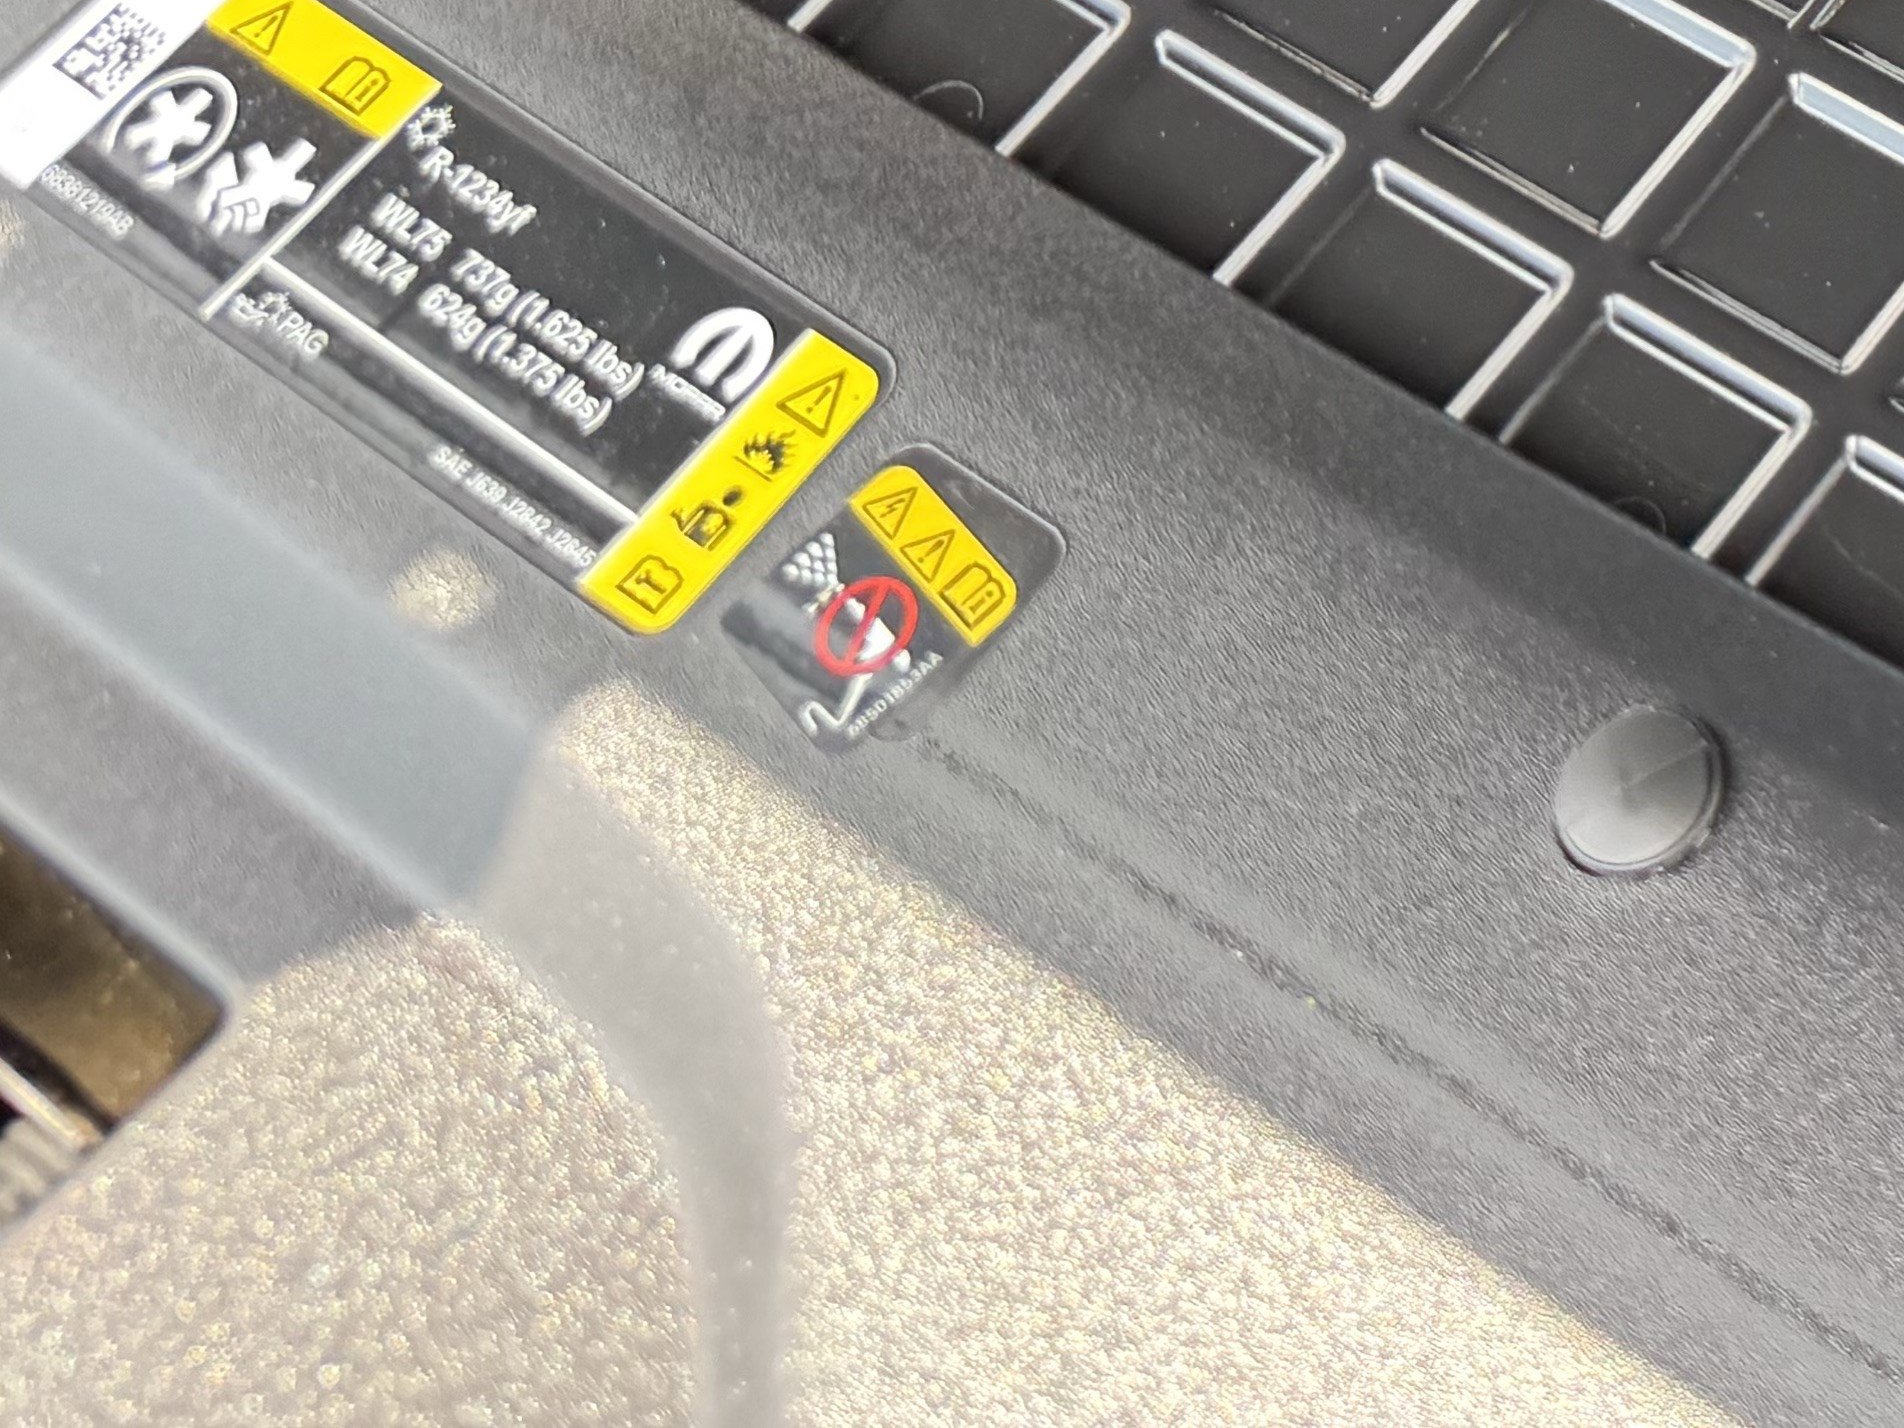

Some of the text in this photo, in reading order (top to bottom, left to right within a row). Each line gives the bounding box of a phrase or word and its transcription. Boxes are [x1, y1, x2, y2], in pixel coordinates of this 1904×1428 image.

[418, 145, 538, 237] R-1234yf
[276, 310, 330, 360] PAG
[337, 225, 613, 436] WL74 624g (1.375 lbs)
[370, 193, 645, 401] WL75 737g (1.625 lbs)
[431, 445, 474, 482] SAE
